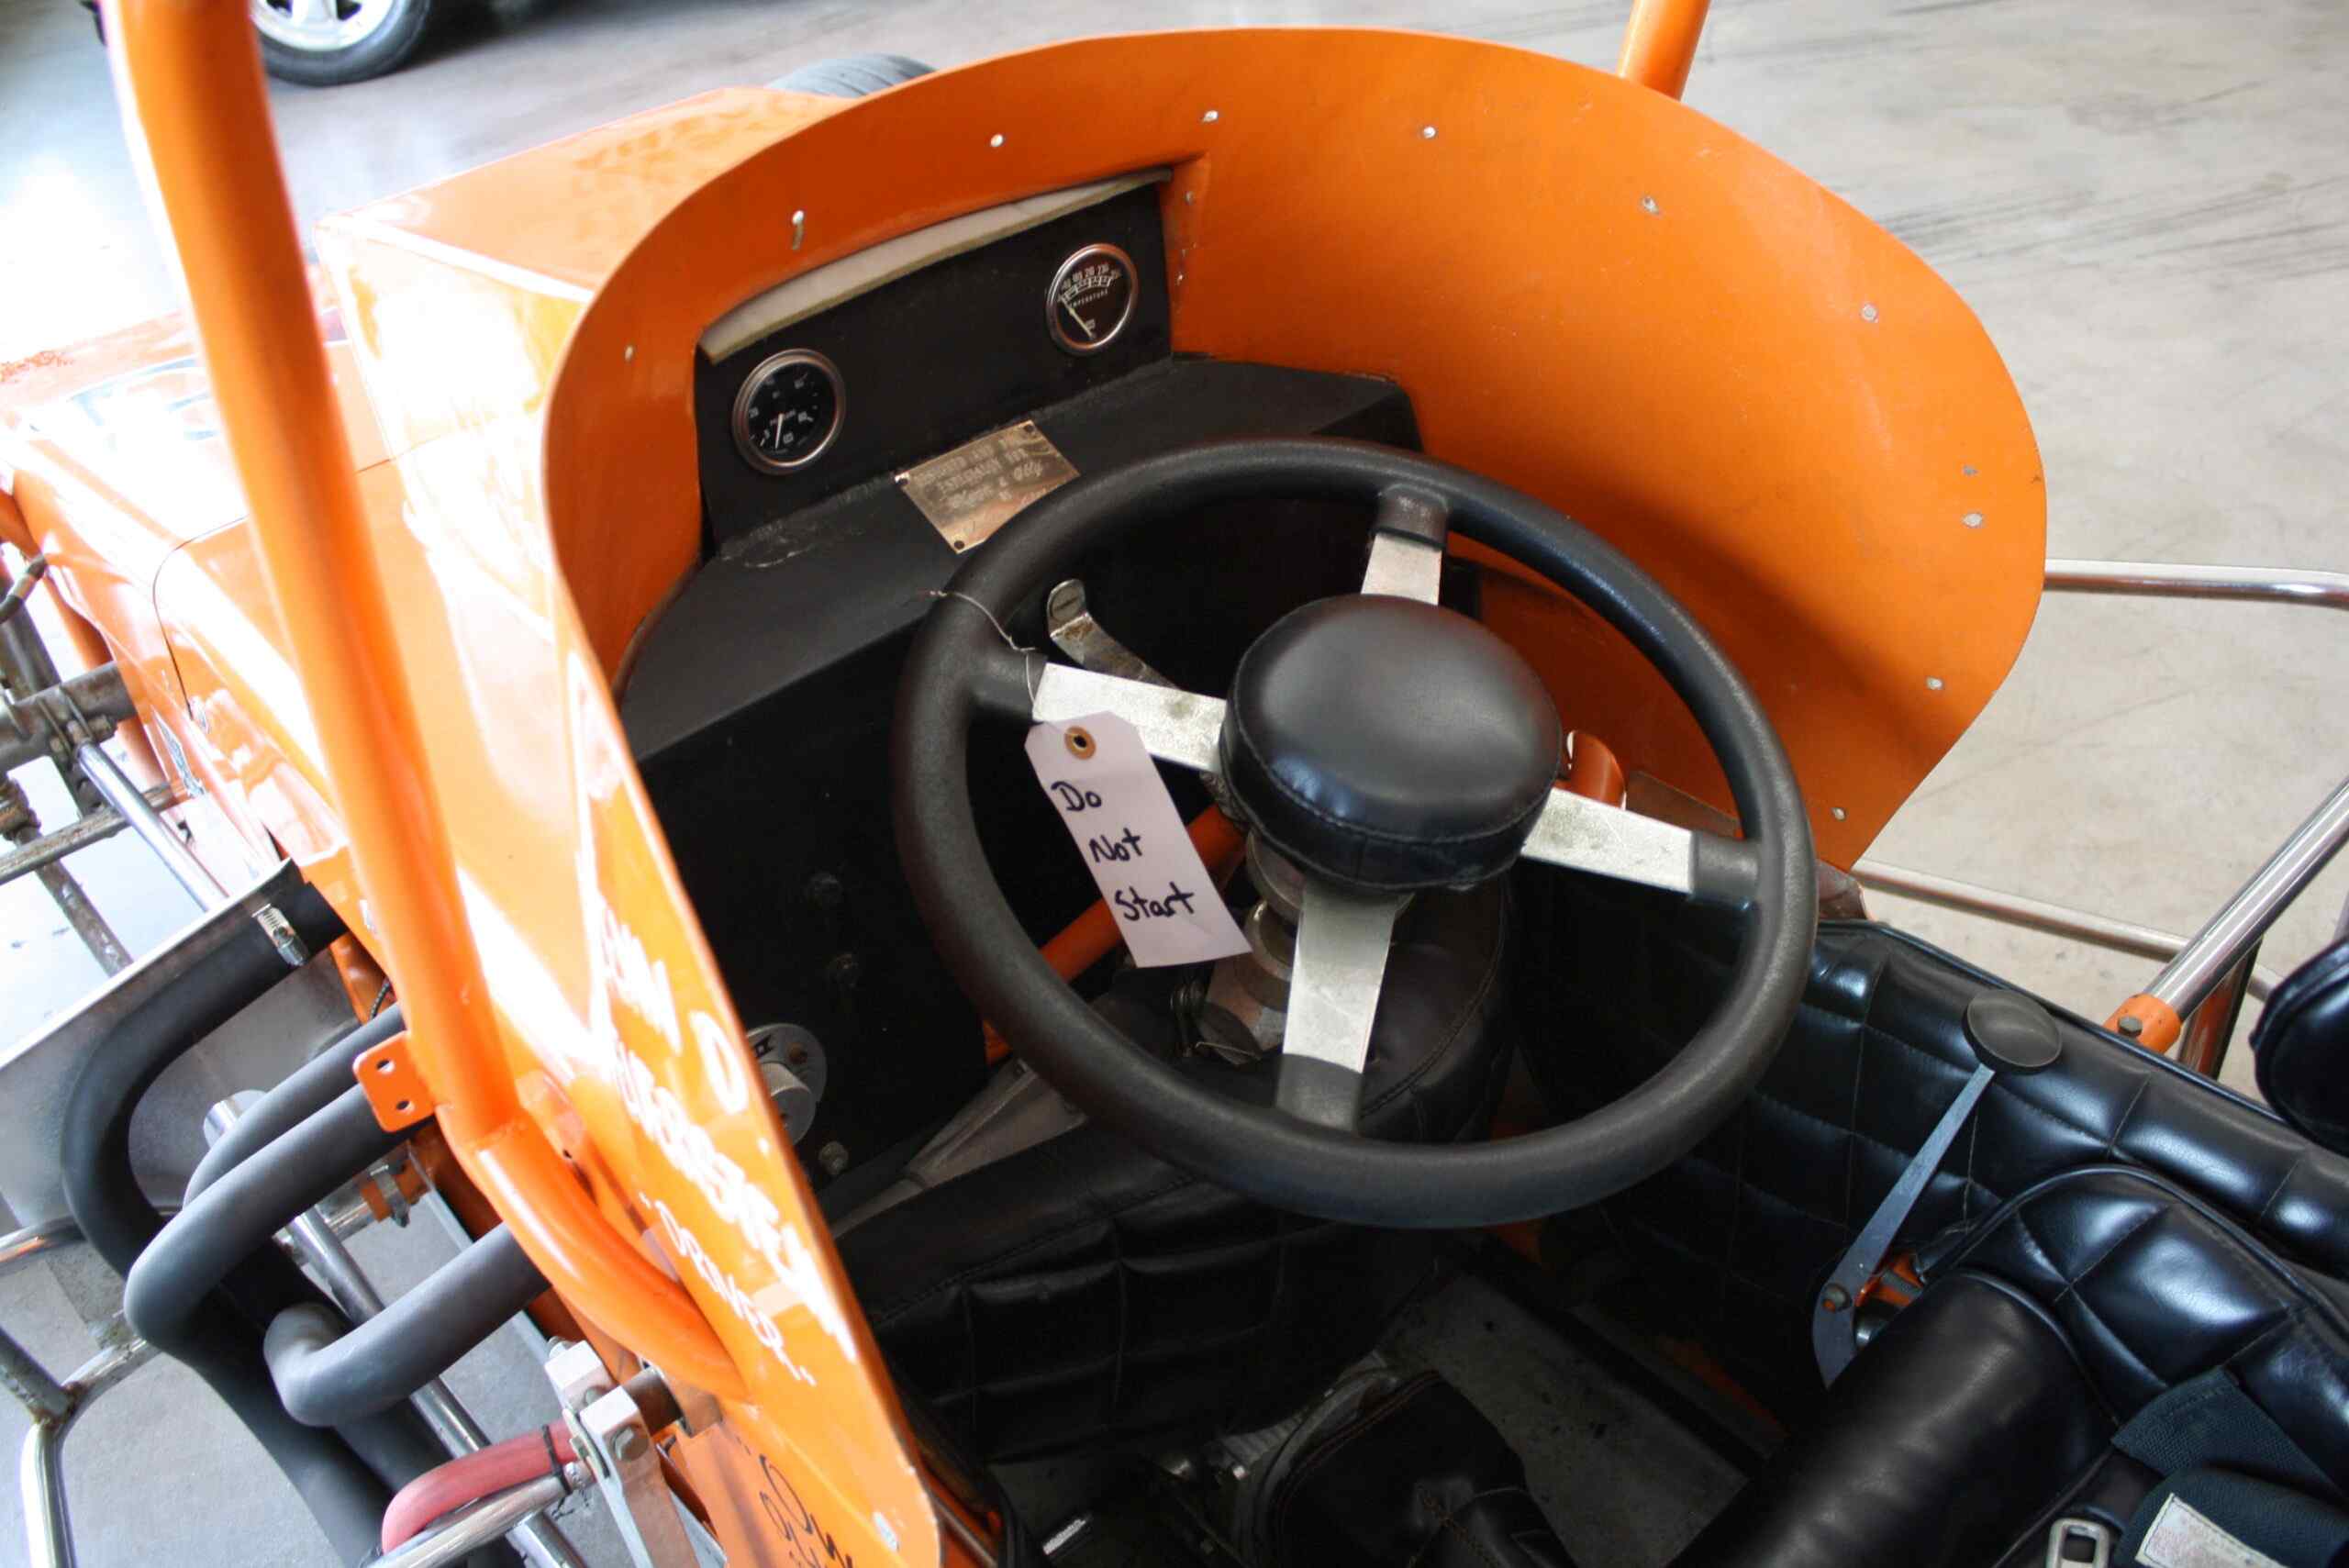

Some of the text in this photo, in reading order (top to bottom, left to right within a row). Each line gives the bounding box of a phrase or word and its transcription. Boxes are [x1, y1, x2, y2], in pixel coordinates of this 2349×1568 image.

[1051, 781, 1102, 812] Do
[1088, 828, 1142, 862] Not
[1114, 881, 1195, 921] Start
